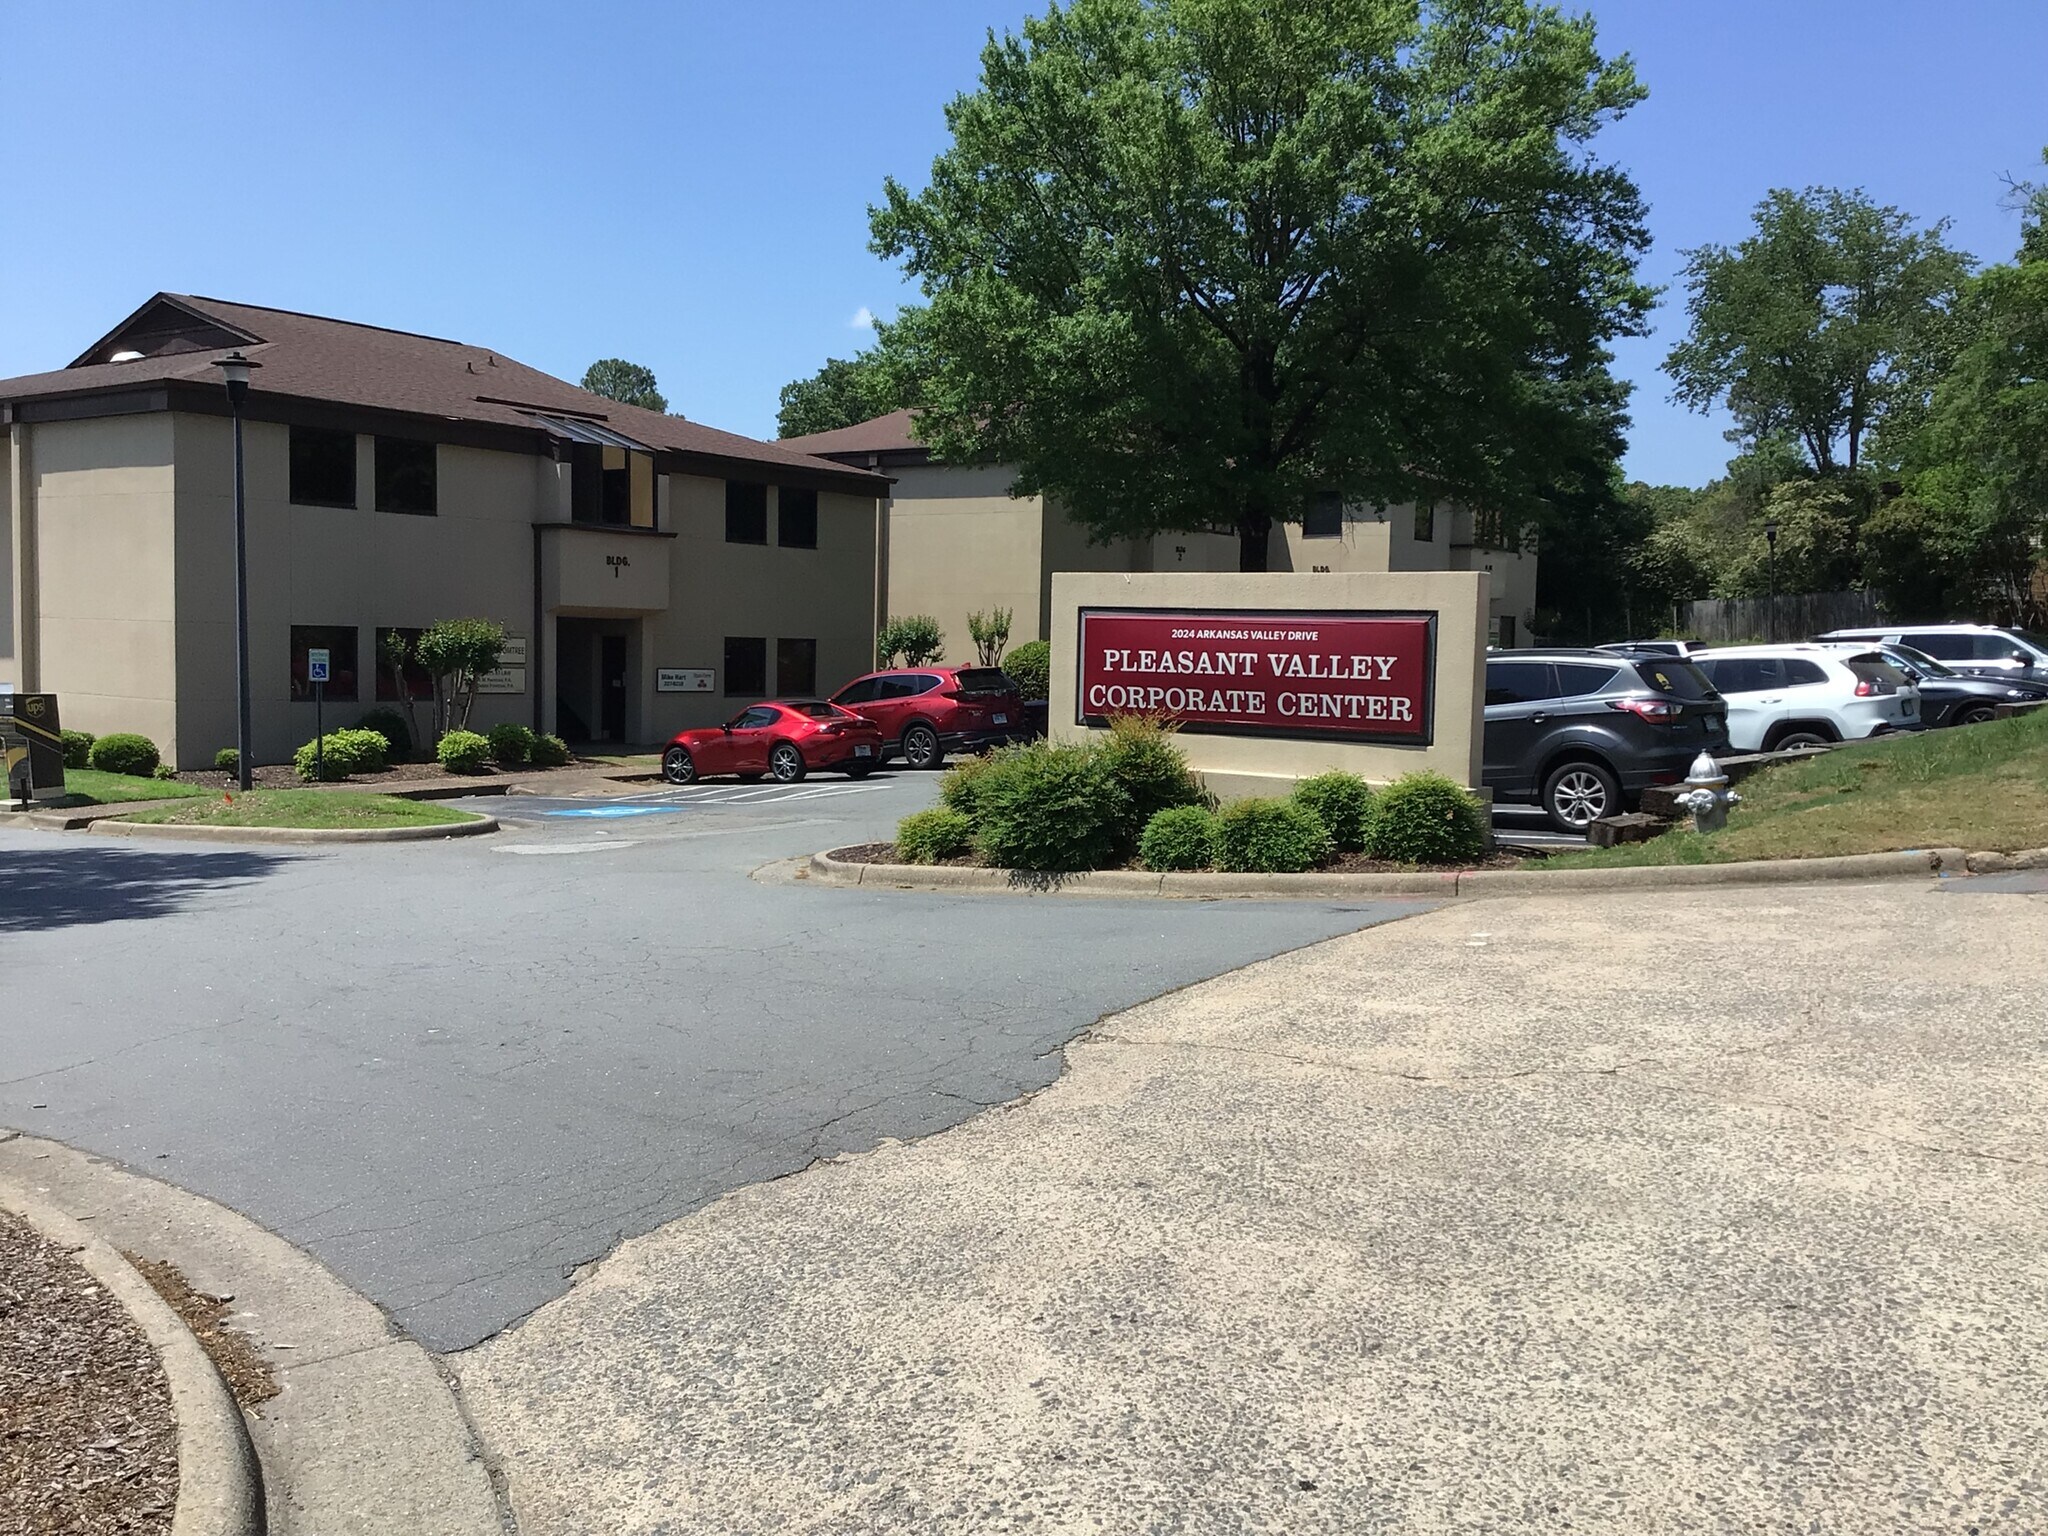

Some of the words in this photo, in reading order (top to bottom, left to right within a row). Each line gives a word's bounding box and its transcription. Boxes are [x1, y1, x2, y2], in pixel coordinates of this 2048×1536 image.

[606, 556, 630, 567] BLDG.
[614, 566, 619, 578] 1
[1171, 628, 1196, 639] 2024
[1197, 629, 1249, 640] ARKANSAS
[1250, 630, 1287, 641] VALLEY
[1287, 631, 1319, 642] DRIVE
[1103, 649, 1258, 677] PLEASANT
[1267, 653, 1398, 681] VALLEY
[27, 703, 44, 714] ups
[1089, 684, 1266, 714] CORPORATE
[1277, 692, 1413, 722] CENTER
